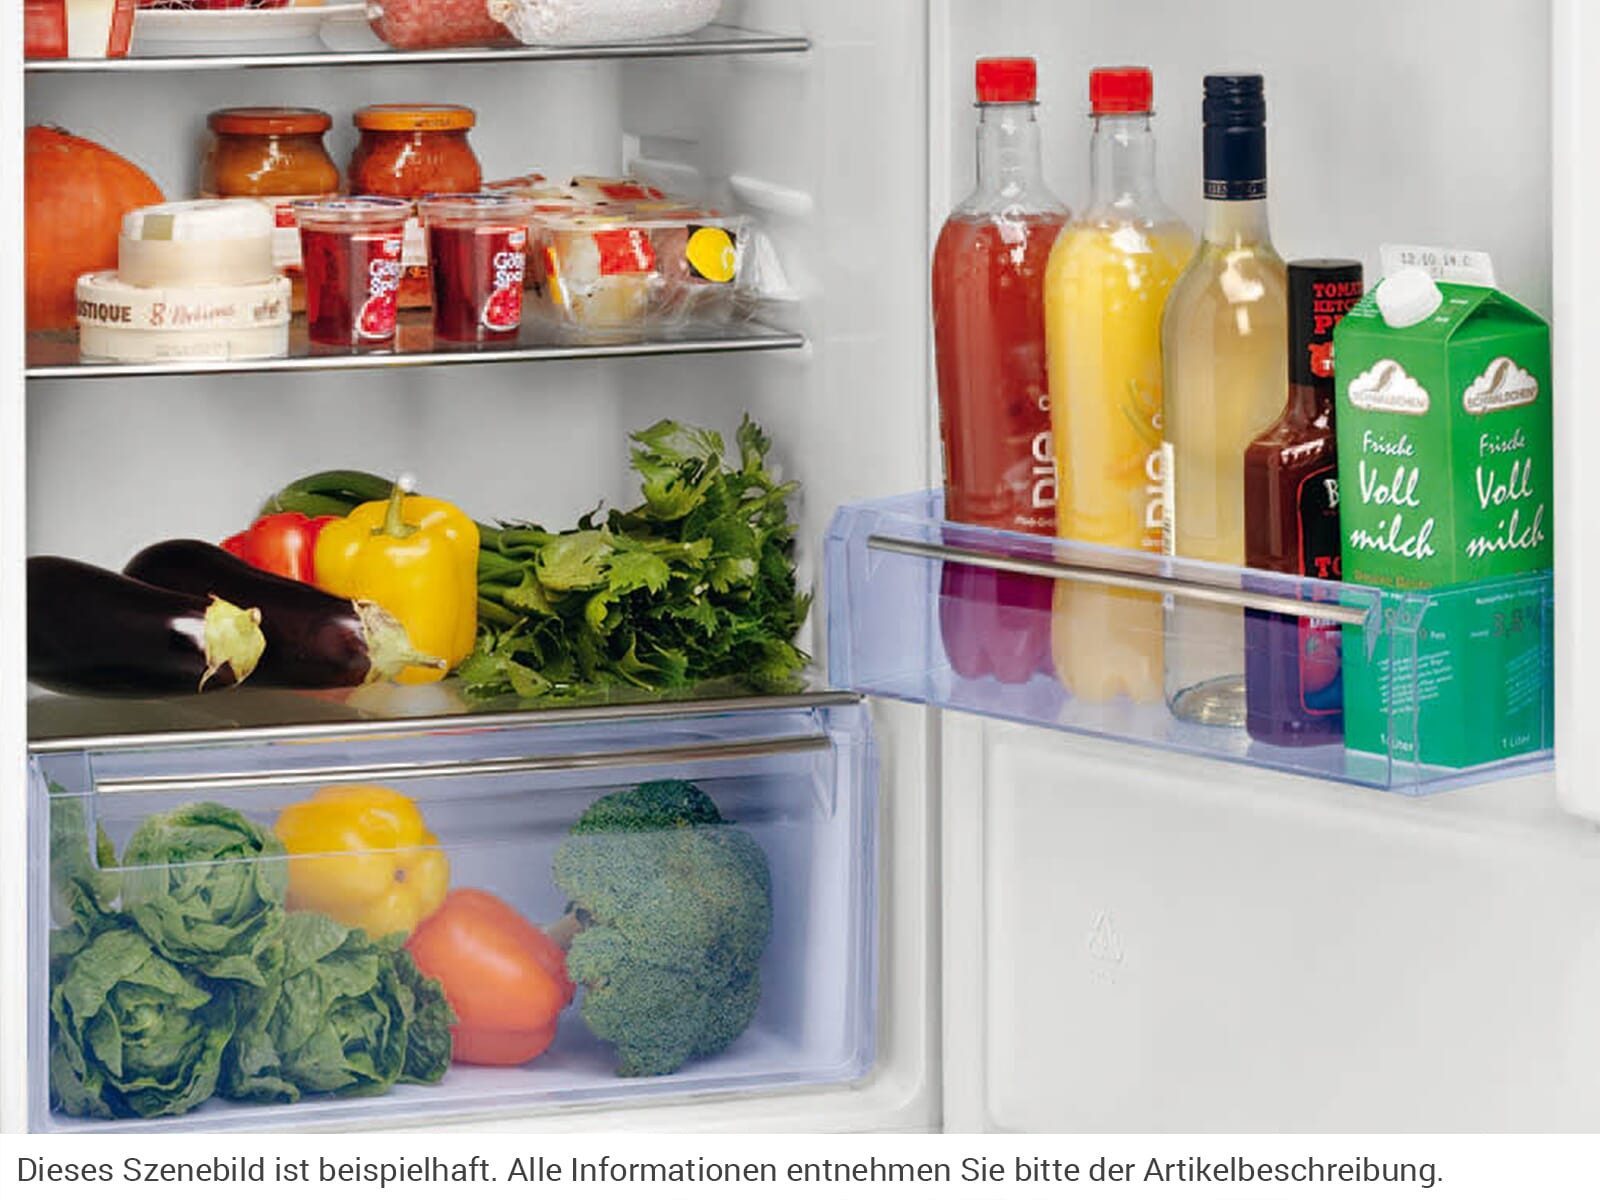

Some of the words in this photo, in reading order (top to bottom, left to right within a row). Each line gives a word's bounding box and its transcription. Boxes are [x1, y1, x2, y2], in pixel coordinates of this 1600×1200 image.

[1363, 429, 1414, 456] Frische
[1479, 428, 1526, 457] Frische
[1359, 459, 1420, 507] Voll
[1476, 457, 1533, 509] Voll
[1350, 513, 1435, 560] milch
[1466, 503, 1545, 558] milch
